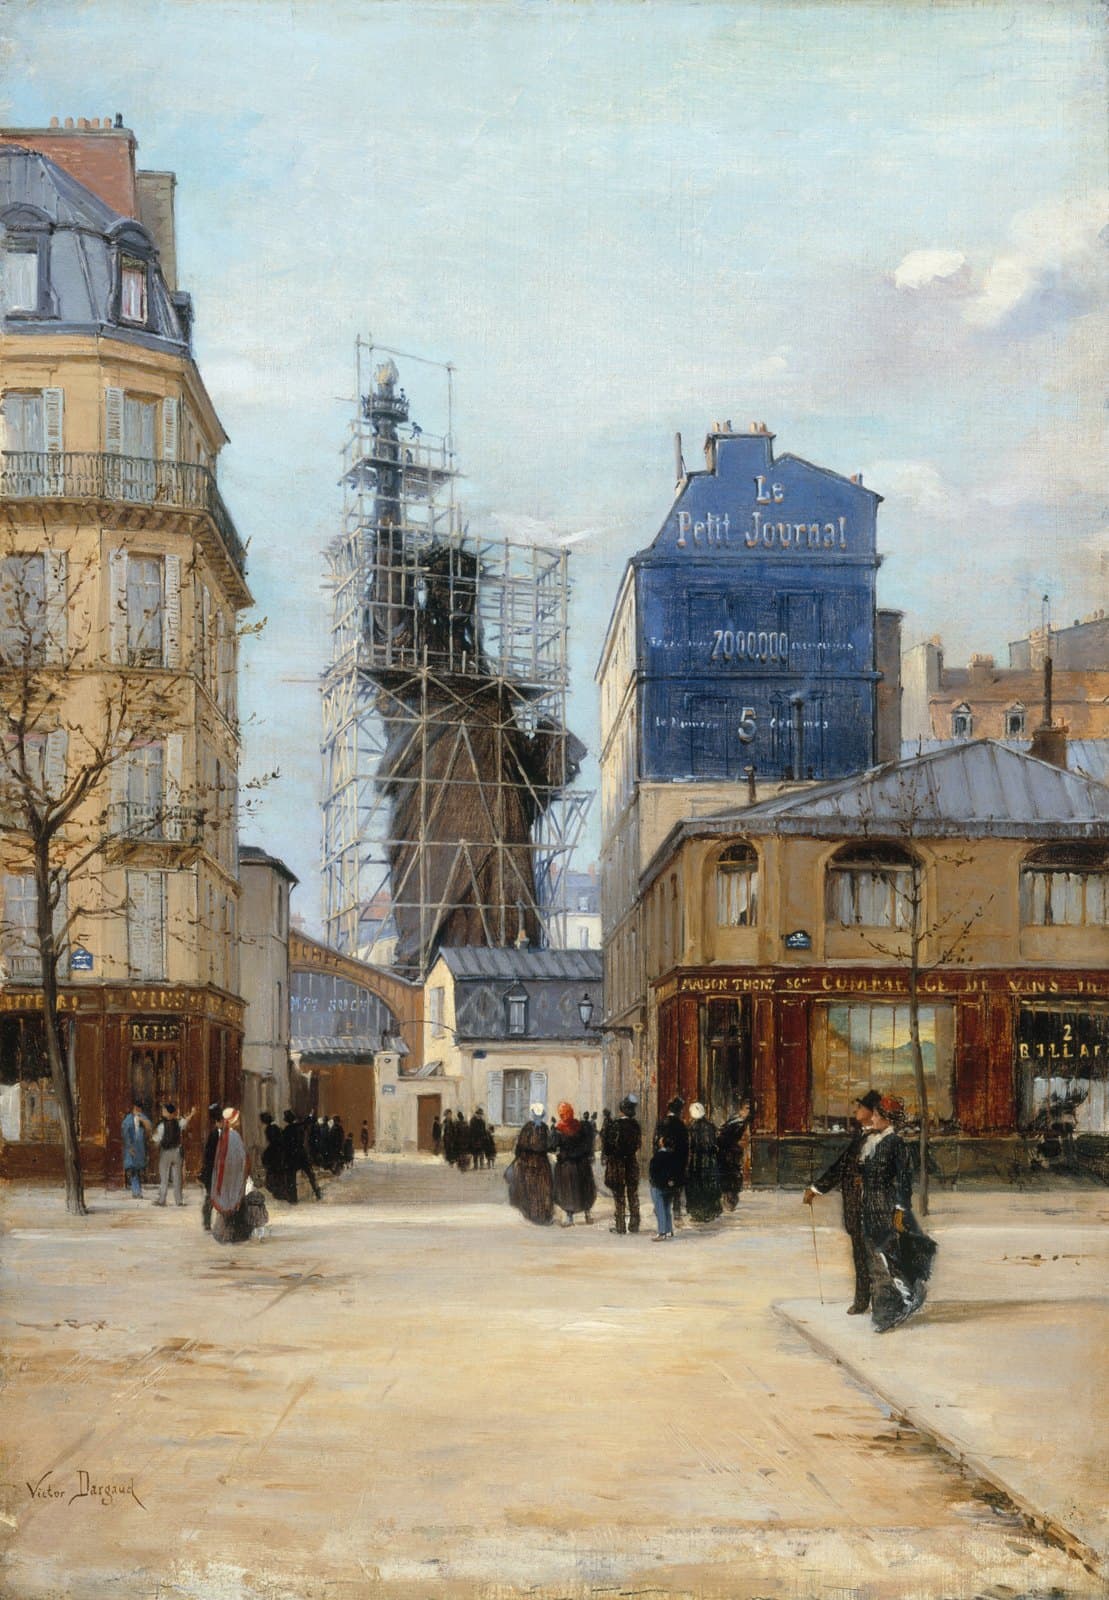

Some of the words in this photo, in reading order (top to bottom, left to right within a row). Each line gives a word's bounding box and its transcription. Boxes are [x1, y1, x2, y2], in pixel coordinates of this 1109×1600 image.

[755, 475, 785, 504] Le
[677, 512, 730, 548] Petit
[745, 512, 847, 549] Journal
[738, 707, 757, 744] 5
[681, 978, 728, 991] MAISON
[822, 974, 947, 992] COMMECE
[1063, 1024, 1073, 1041] 2
[26, 1471, 65, 1498] Victor
[68, 1470, 147, 1510] Dargaud
